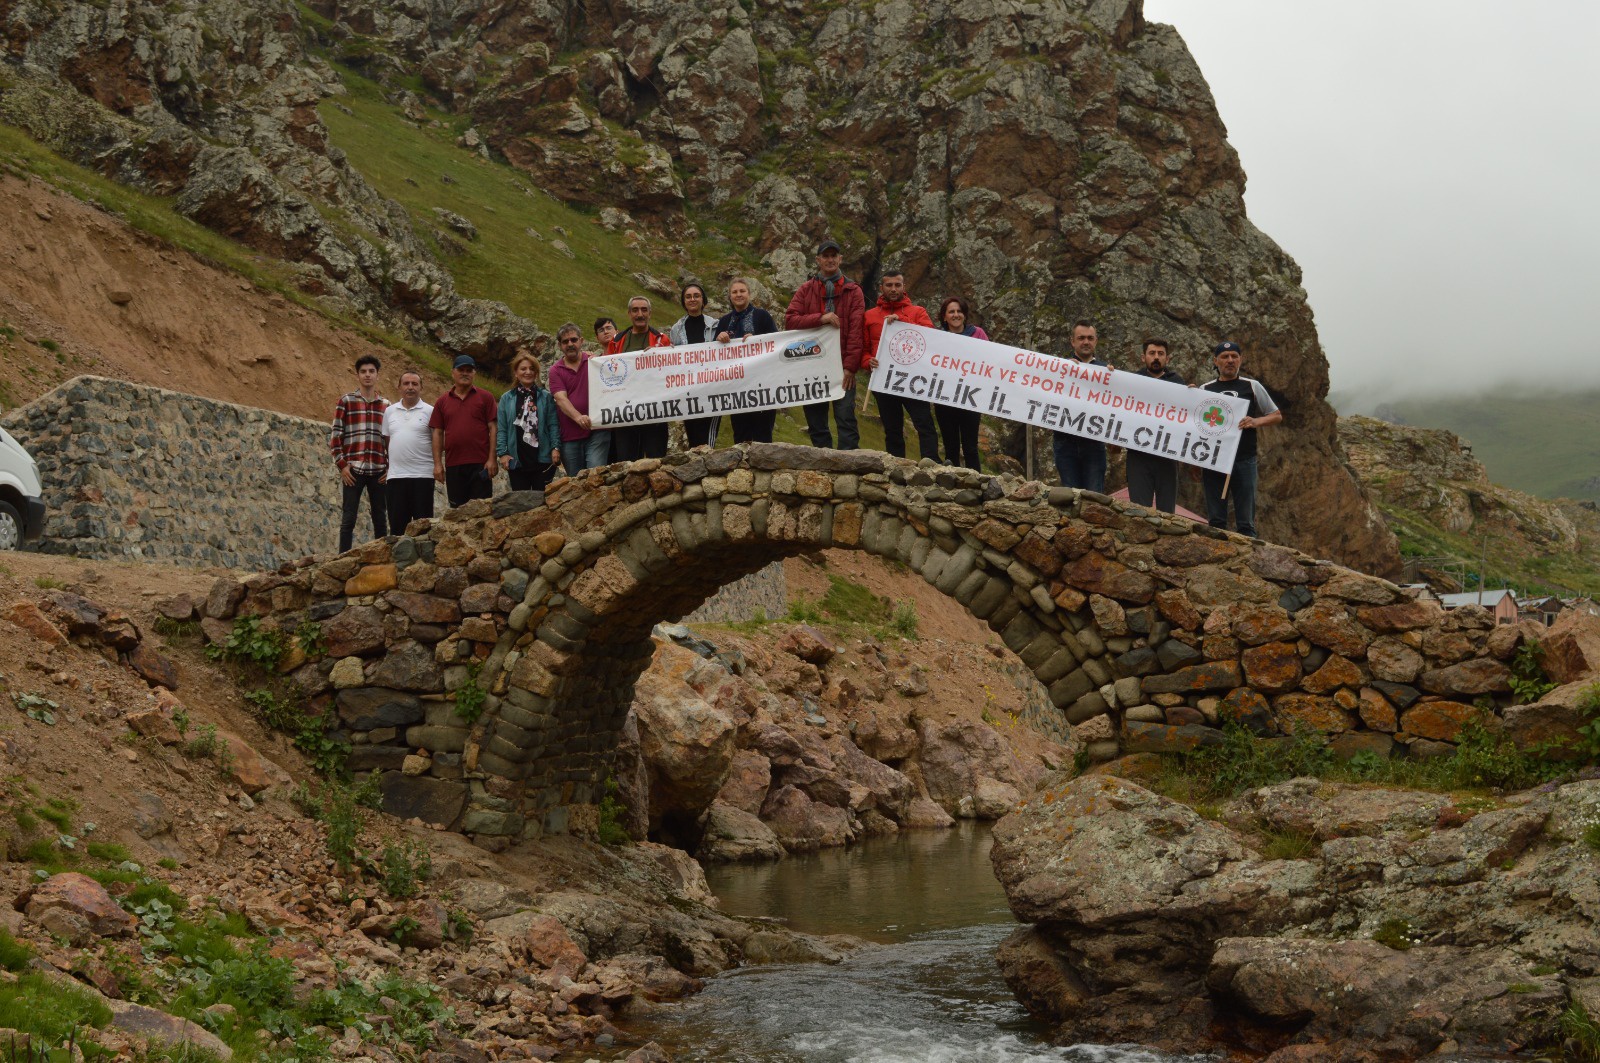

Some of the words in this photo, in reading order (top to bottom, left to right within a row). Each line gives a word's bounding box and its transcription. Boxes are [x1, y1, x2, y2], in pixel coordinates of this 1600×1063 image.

[635, 351, 682, 371] GÜMÜŞHANE
[684, 346, 717, 366] GENÇLİK
[719, 339, 763, 361] HİZMETLERİ
[765, 340, 775, 353] VE
[1014, 352, 1112, 386] GÜMÜŞHANE
[665, 373, 686, 389] SPOR
[687, 370, 695, 386] İL
[697, 364, 745, 384] MÜDÜRLÜĞÜ
[930, 354, 996, 379] GENÇLİK
[999, 367, 1018, 383] VE
[1020, 374, 1065, 395] SPOR
[1068, 382, 1082, 399] İL
[1087, 389, 1189, 424] MÜDÜRLÜĞÜ
[600, 399, 684, 425] DAĞCILIK
[686, 391, 705, 416] İL
[707, 375, 831, 413] TEMSİLCİLİĞİ
[883, 364, 982, 408] İZCİLİK
[987, 386, 1012, 416] İL
[1026, 398, 1222, 466] TEMSİLCİLİĞİ
